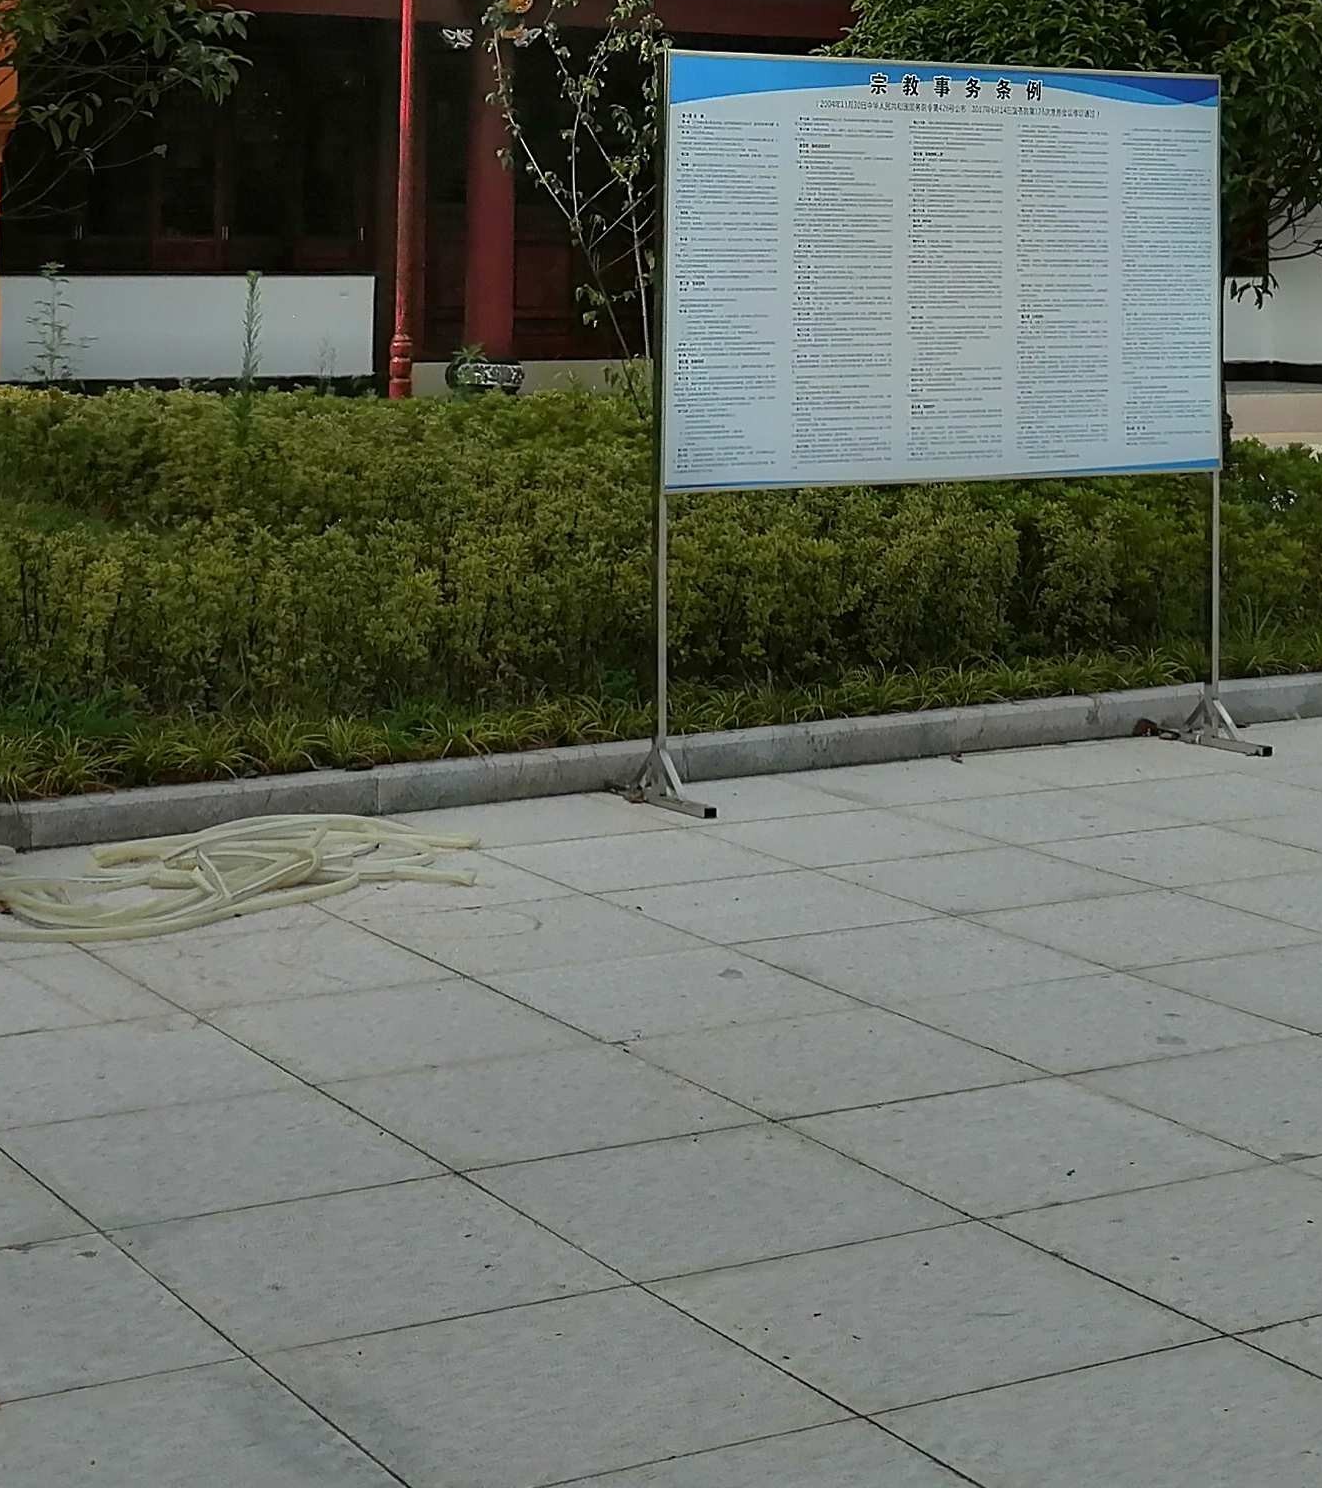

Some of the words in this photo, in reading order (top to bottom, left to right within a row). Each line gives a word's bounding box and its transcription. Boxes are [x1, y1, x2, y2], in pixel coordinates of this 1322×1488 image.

[870, 73, 1042, 101] 宗教事务条例
